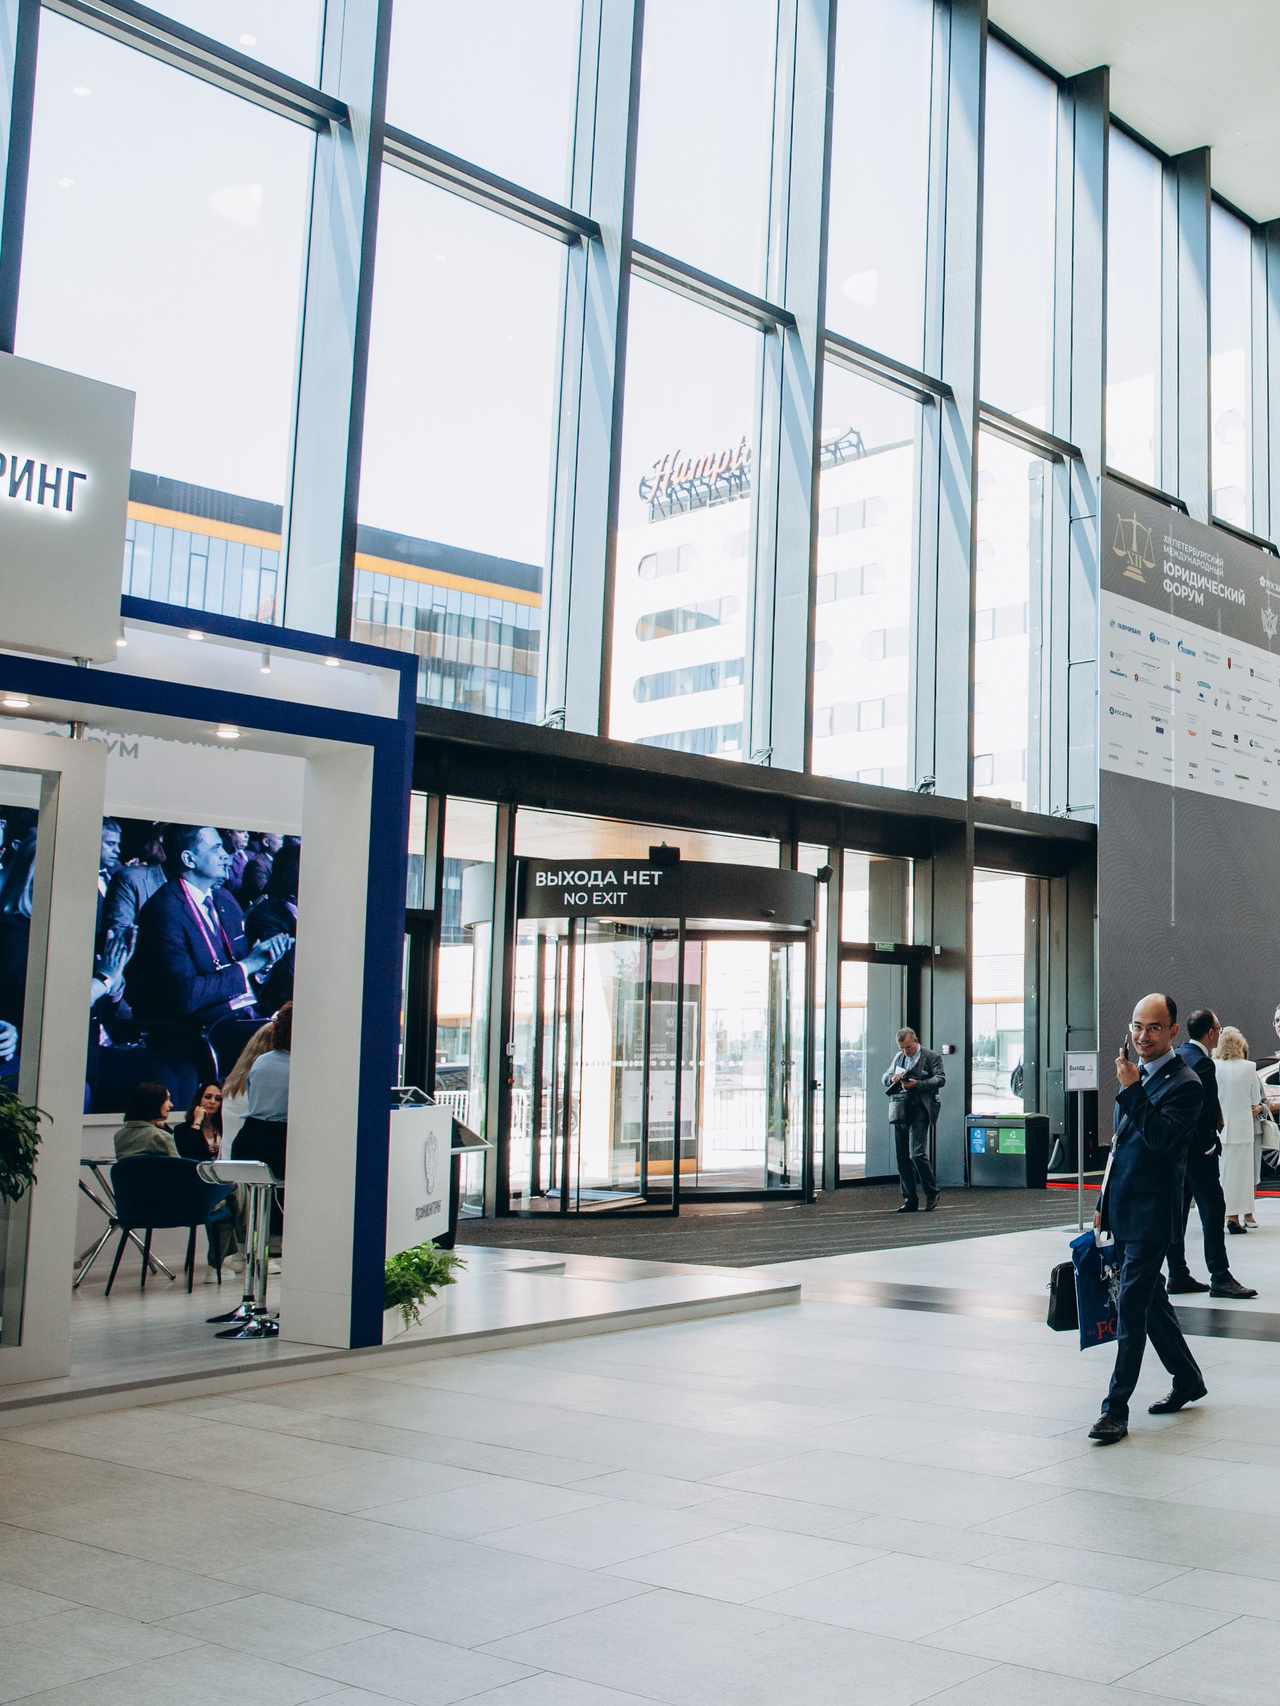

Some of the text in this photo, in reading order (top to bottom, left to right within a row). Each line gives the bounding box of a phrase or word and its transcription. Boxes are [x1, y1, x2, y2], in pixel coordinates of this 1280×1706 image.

[1163, 545, 1224, 577] МЕЖДУНАРОДНЫЙ
[1173, 538, 1224, 568] ПЕТЕРБУРГСКИЙ
[1163, 560, 1246, 606] ЮРИДИЧЕСКИЙ
[1163, 579, 1204, 607] ФОРУМ
[535, 870, 664, 887] ВЫХОДА НЕТ
[563, 892, 628, 905] NO EXIT
